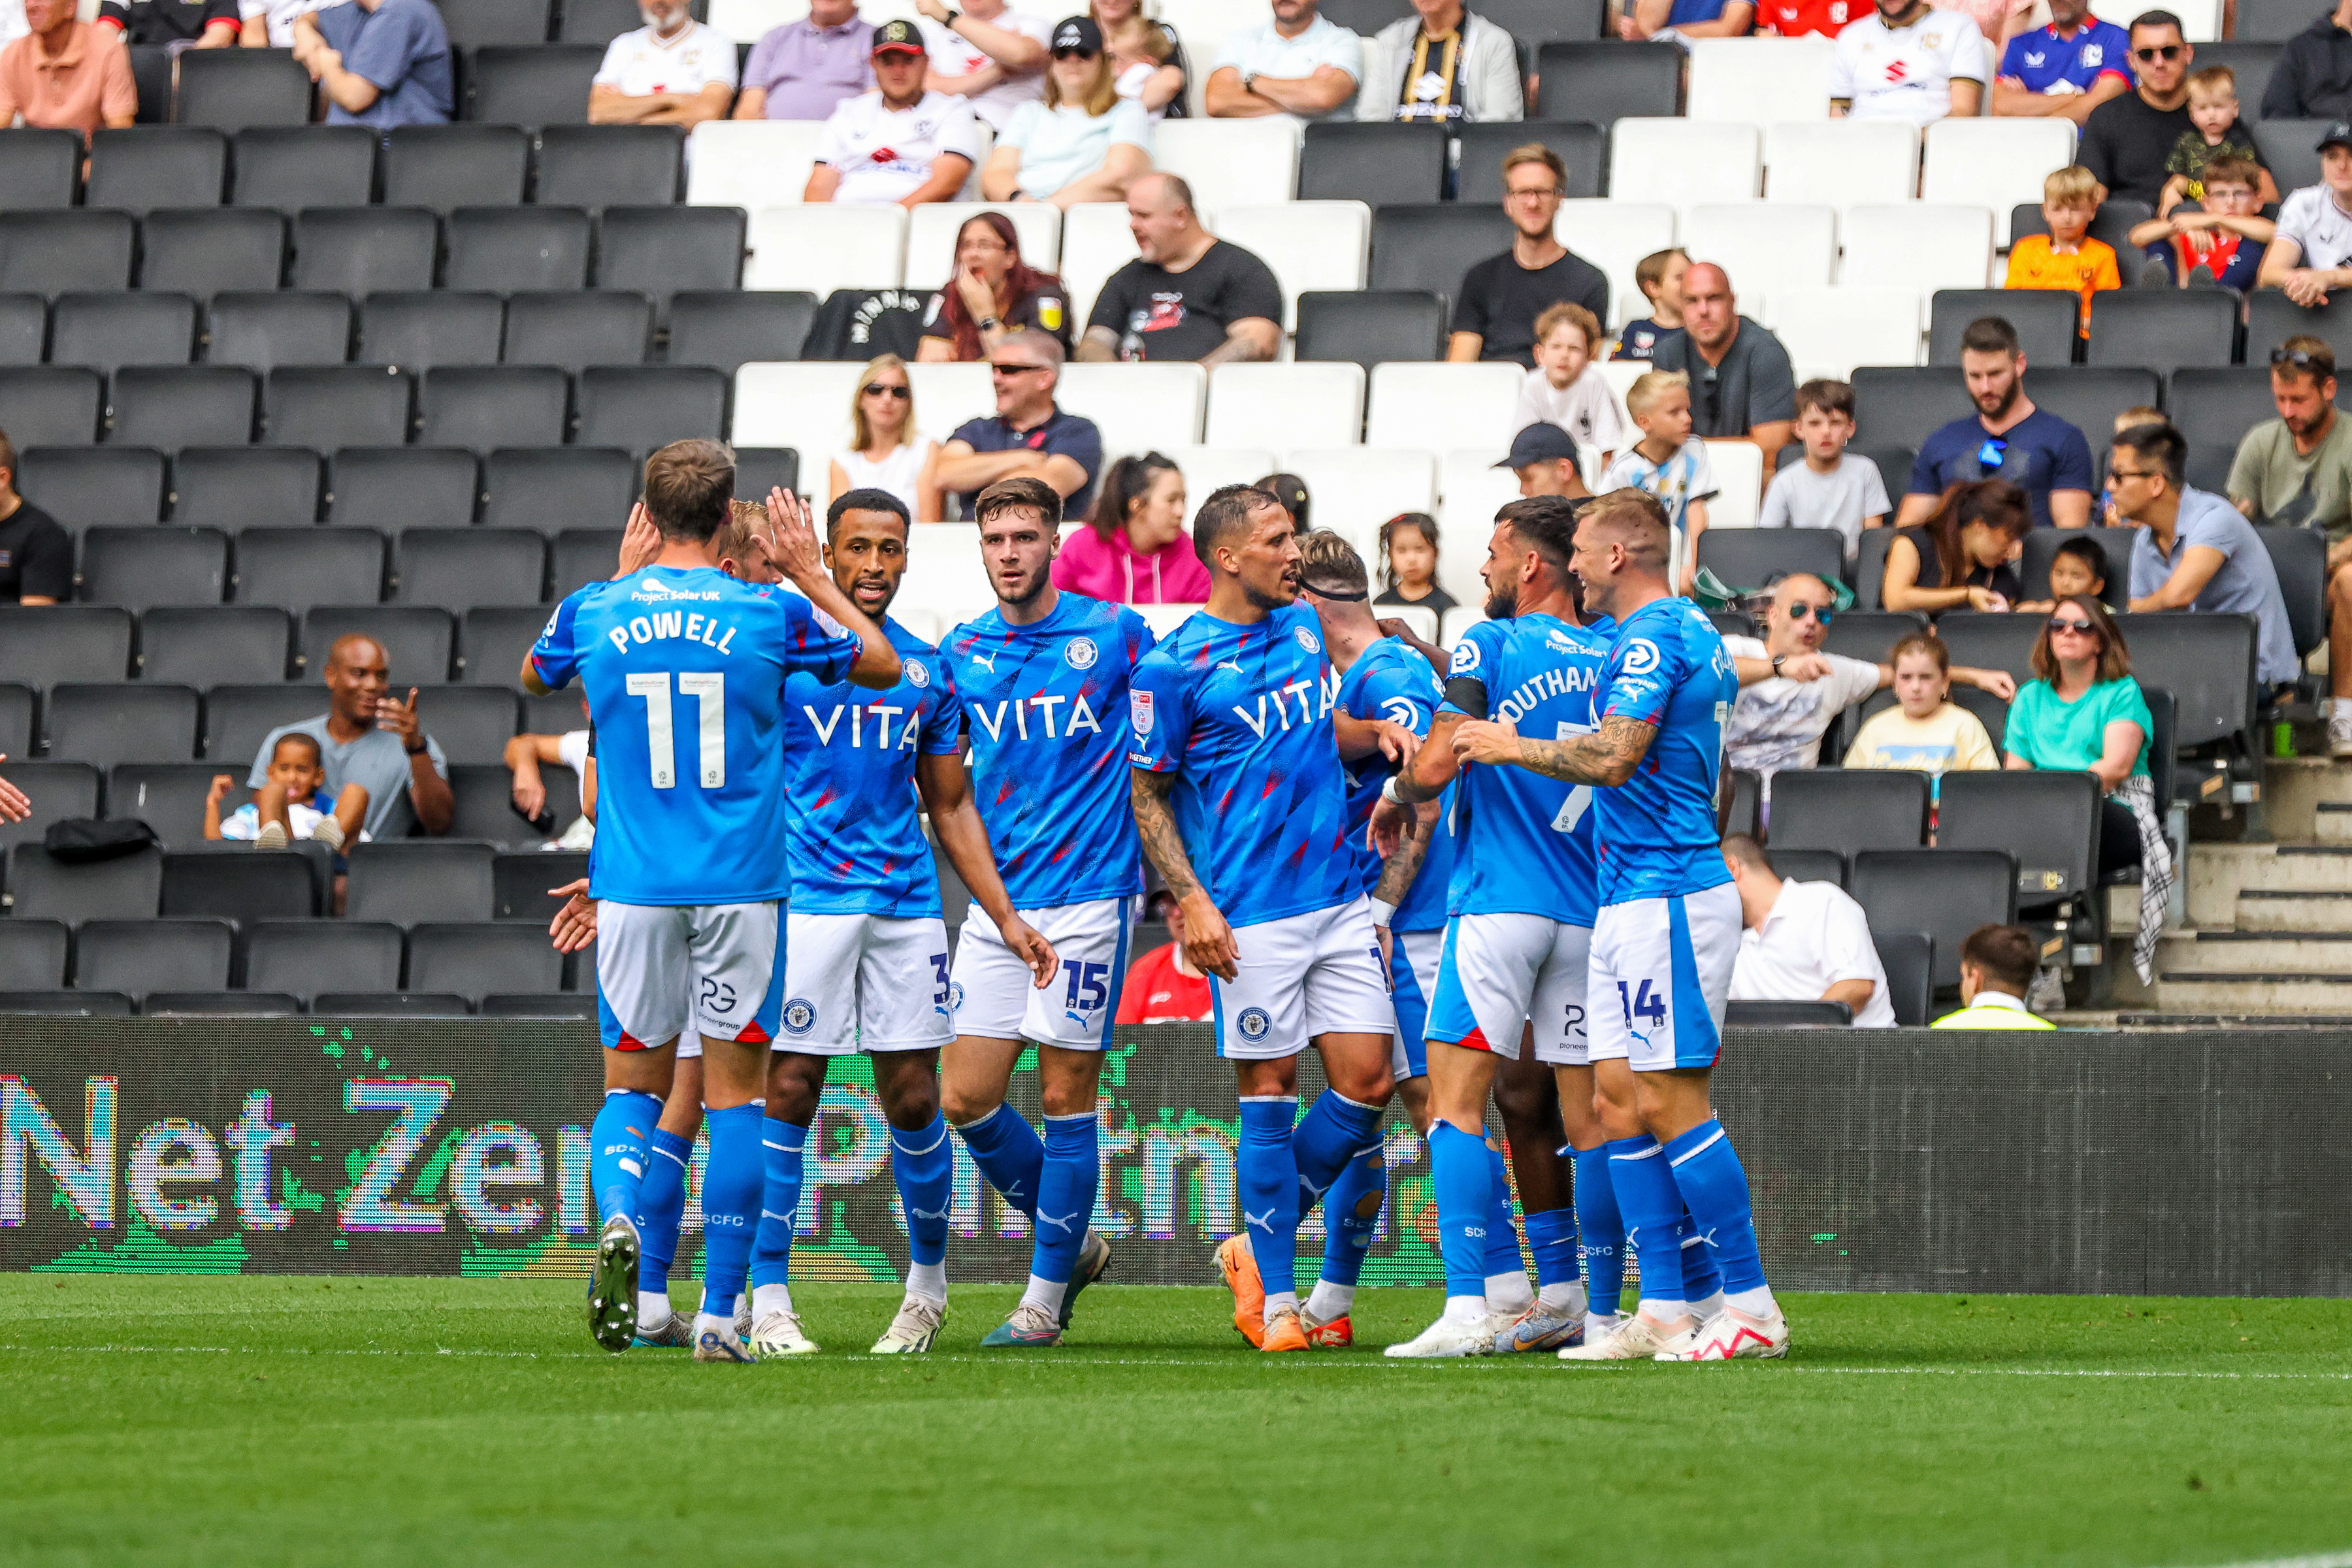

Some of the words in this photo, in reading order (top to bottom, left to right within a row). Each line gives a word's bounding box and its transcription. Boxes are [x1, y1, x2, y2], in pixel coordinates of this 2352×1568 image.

[631, 591, 669, 606] Project
[670, 589, 700, 600] Solar
[702, 591, 721, 600] UK
[608, 610, 737, 655] POWELL
[1545, 639, 1578, 655] Project
[625, 671, 726, 789] 11
[803, 704, 920, 752] VITA
[973, 693, 1102, 743] VITA
[1232, 676, 1333, 740] VITA
[930, 953, 951, 1005] 3
[1063, 959, 1109, 1011] 15
[1617, 979, 1667, 1030] 14
[0, 1074, 296, 1231] Net
[702, 1213, 744, 1227] SCFC
[1582, 1245, 1613, 1256] SCFC
